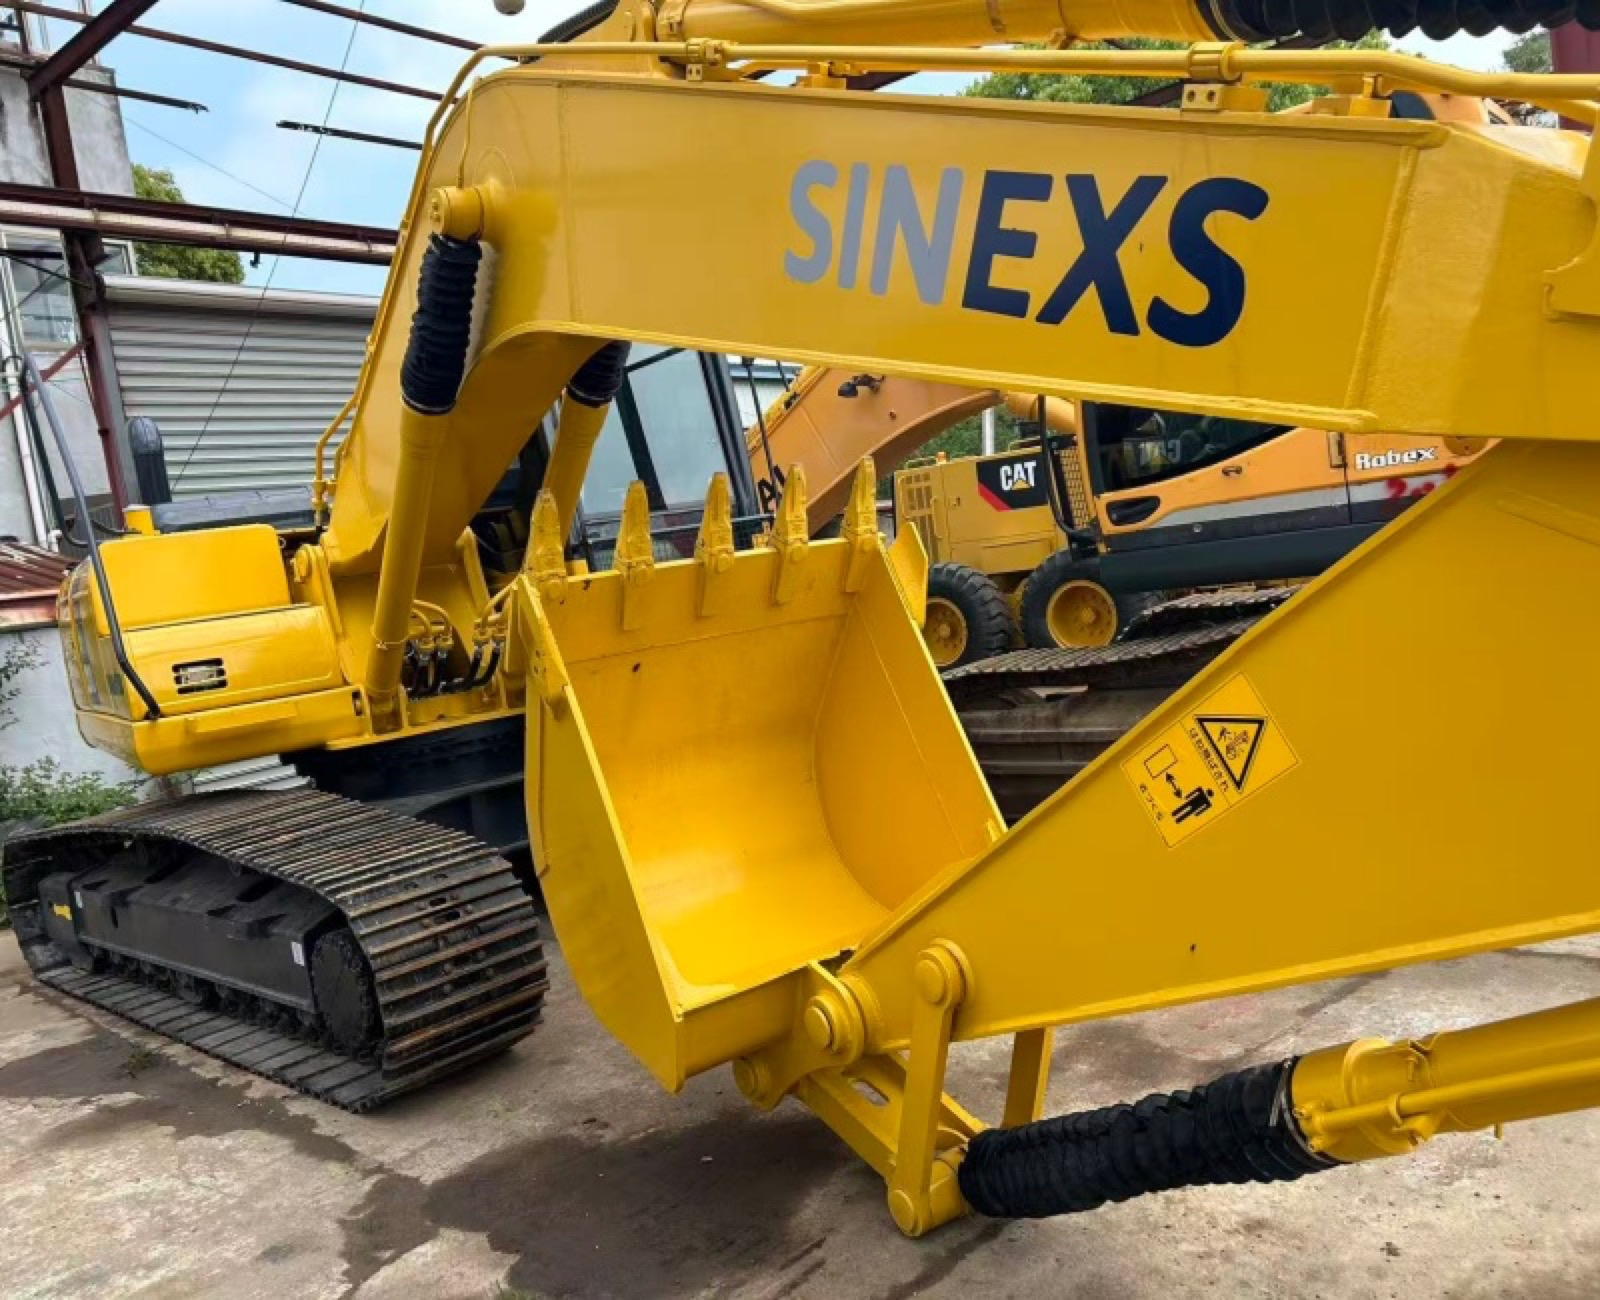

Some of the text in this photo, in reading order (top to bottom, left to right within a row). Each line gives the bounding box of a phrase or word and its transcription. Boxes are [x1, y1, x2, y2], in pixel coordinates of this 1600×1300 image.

[784, 159, 1269, 347] SINEXS
[1355, 446, 1438, 470] Robex
[1000, 460, 1037, 491] CAT
